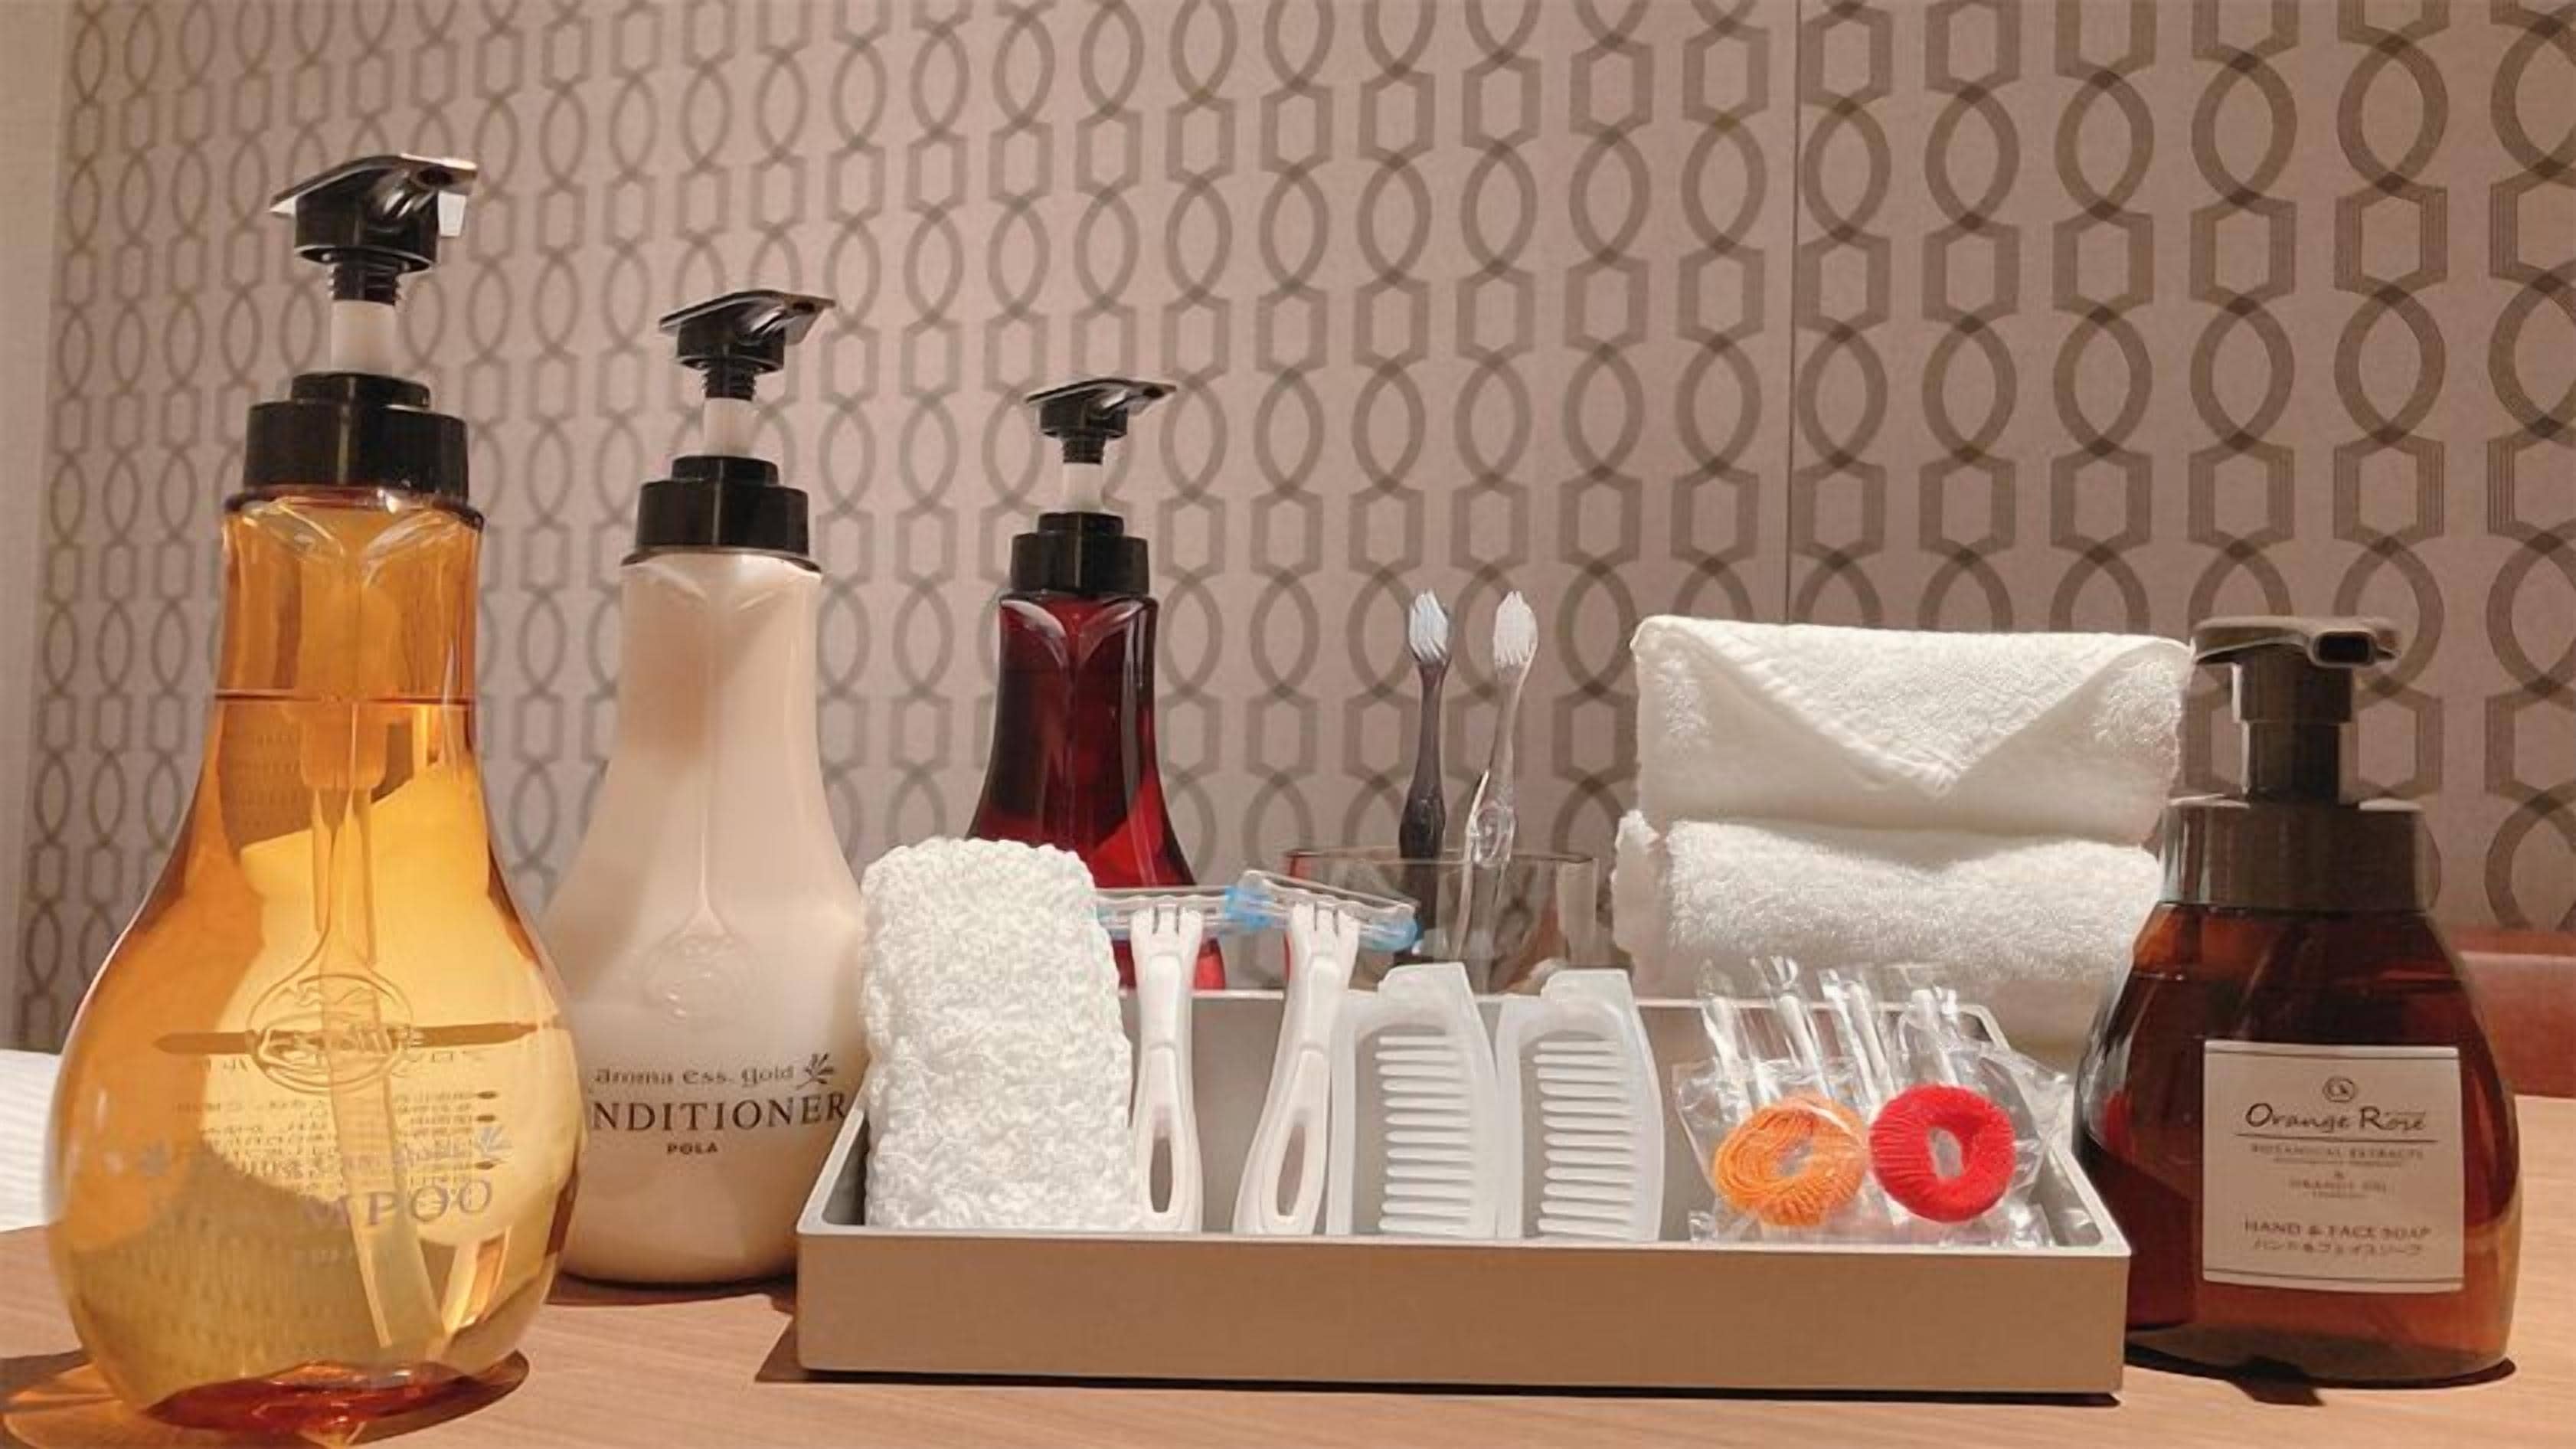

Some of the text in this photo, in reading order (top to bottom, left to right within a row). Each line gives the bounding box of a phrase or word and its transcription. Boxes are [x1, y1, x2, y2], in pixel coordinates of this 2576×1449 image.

[593, 1091, 846, 1132] NDITIONER
[2245, 1102, 2350, 1133] Orange
[666, 1141, 718, 1155] POLA
[2244, 1219, 2302, 1235] HAND
